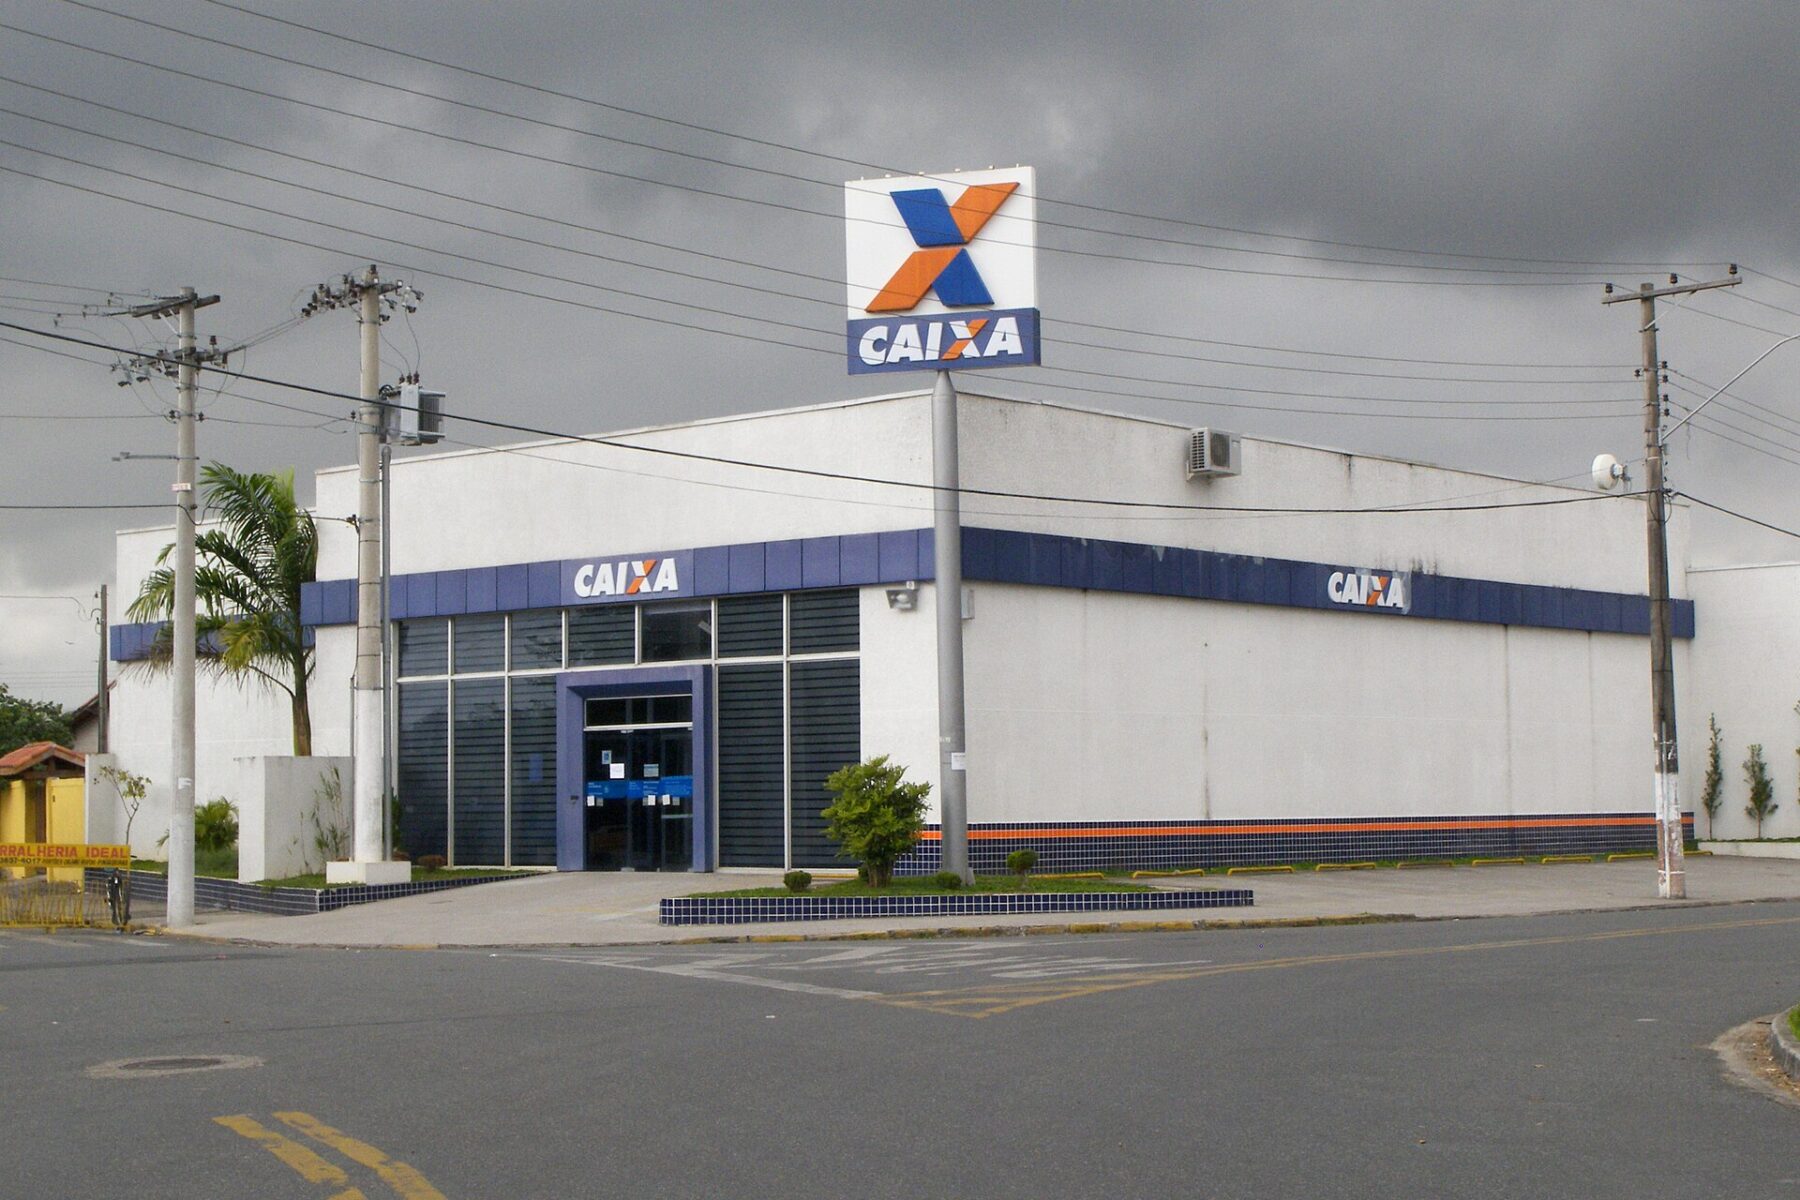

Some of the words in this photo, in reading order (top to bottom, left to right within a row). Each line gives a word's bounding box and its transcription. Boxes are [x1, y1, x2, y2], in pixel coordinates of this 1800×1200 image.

[859, 316, 1024, 366] CAIXA
[574, 558, 679, 598] CAIXA
[1327, 571, 1405, 609] CAIXA
[86, 847, 128, 858] IDEAL
